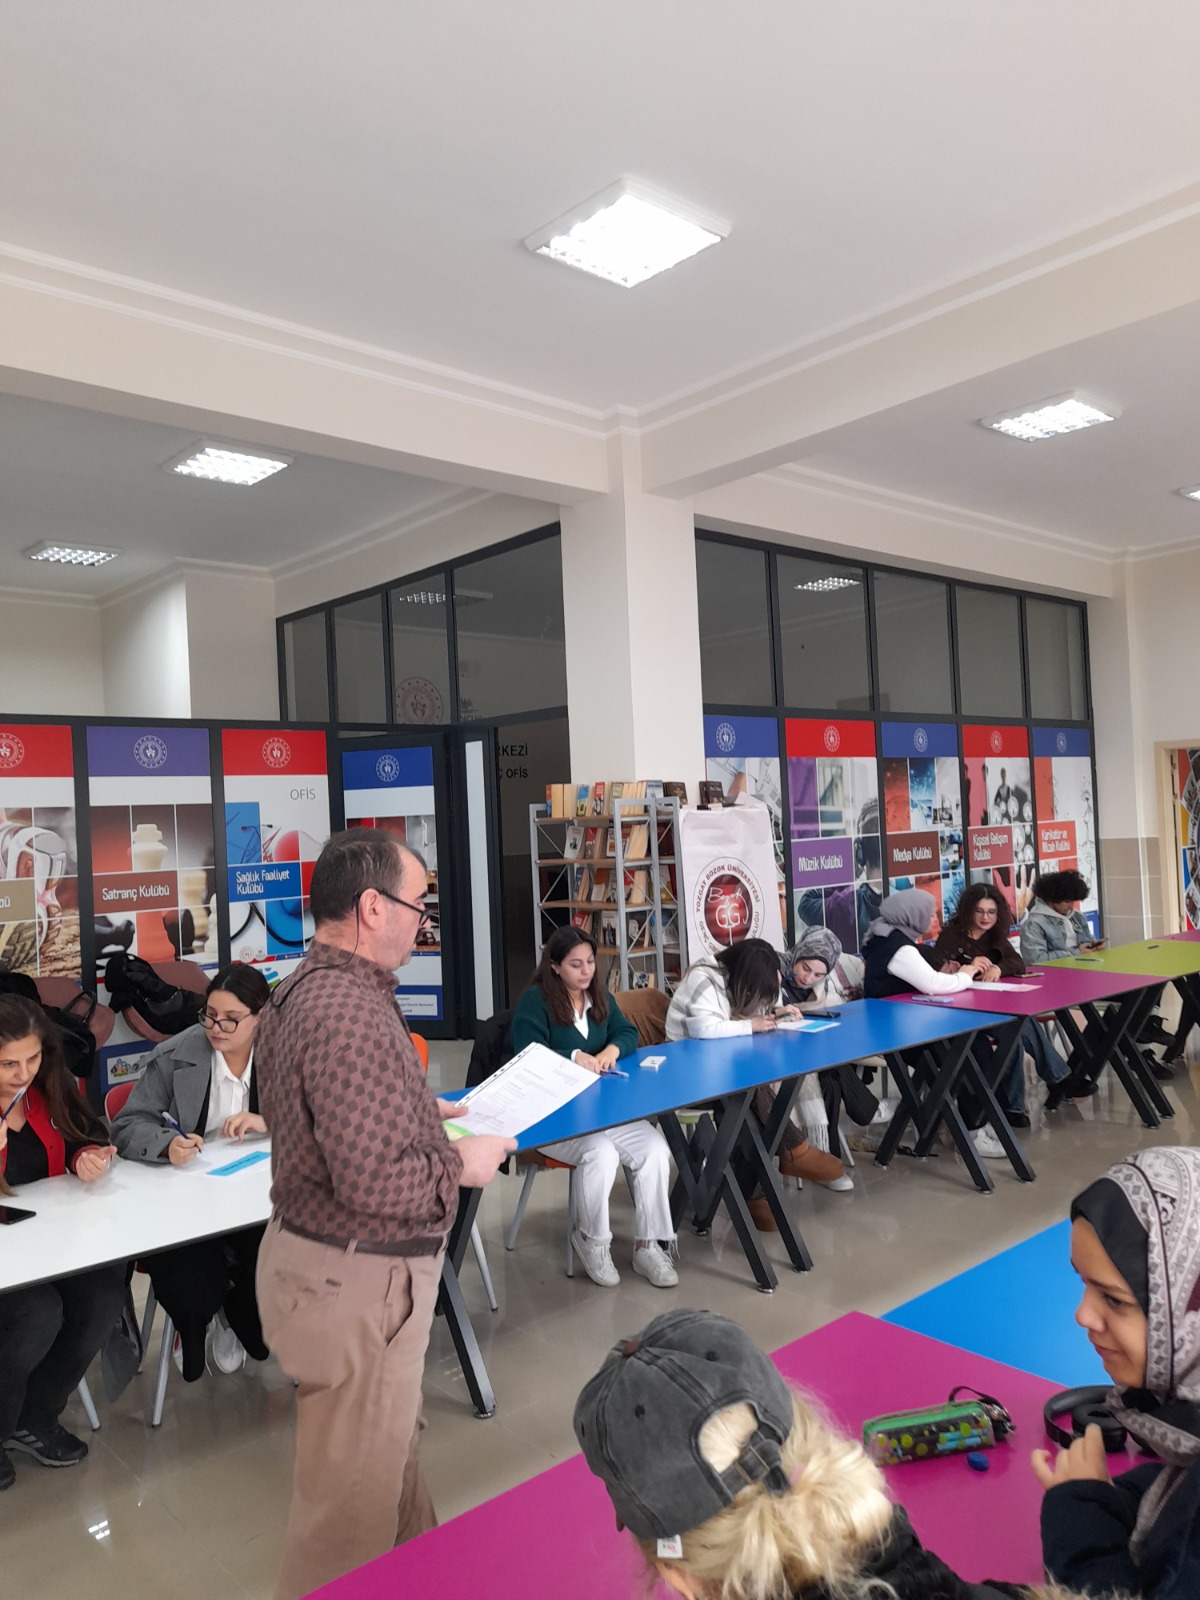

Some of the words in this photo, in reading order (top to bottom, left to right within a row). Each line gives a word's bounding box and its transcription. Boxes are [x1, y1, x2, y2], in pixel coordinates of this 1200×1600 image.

[506, 766, 528, 779] OFİS
[289, 786, 316, 801] OFİS
[893, 848, 912, 863] Medya
[912, 846, 932, 860] Kulübü
[798, 856, 820, 872] Müzik
[820, 854, 844, 870] Kulübü
[235, 870, 261, 884] Sağlık
[261, 868, 290, 881] Faaliyet
[102, 887, 138, 902] Satranç
[138, 884, 170, 898] Kulübü
[236, 883, 264, 896] Kulübü
[696, 880, 707, 913] YOZGAT
[705, 864, 726, 881] BOZOK
[727, 863, 761, 903] ÜNİVERSİTESİ
